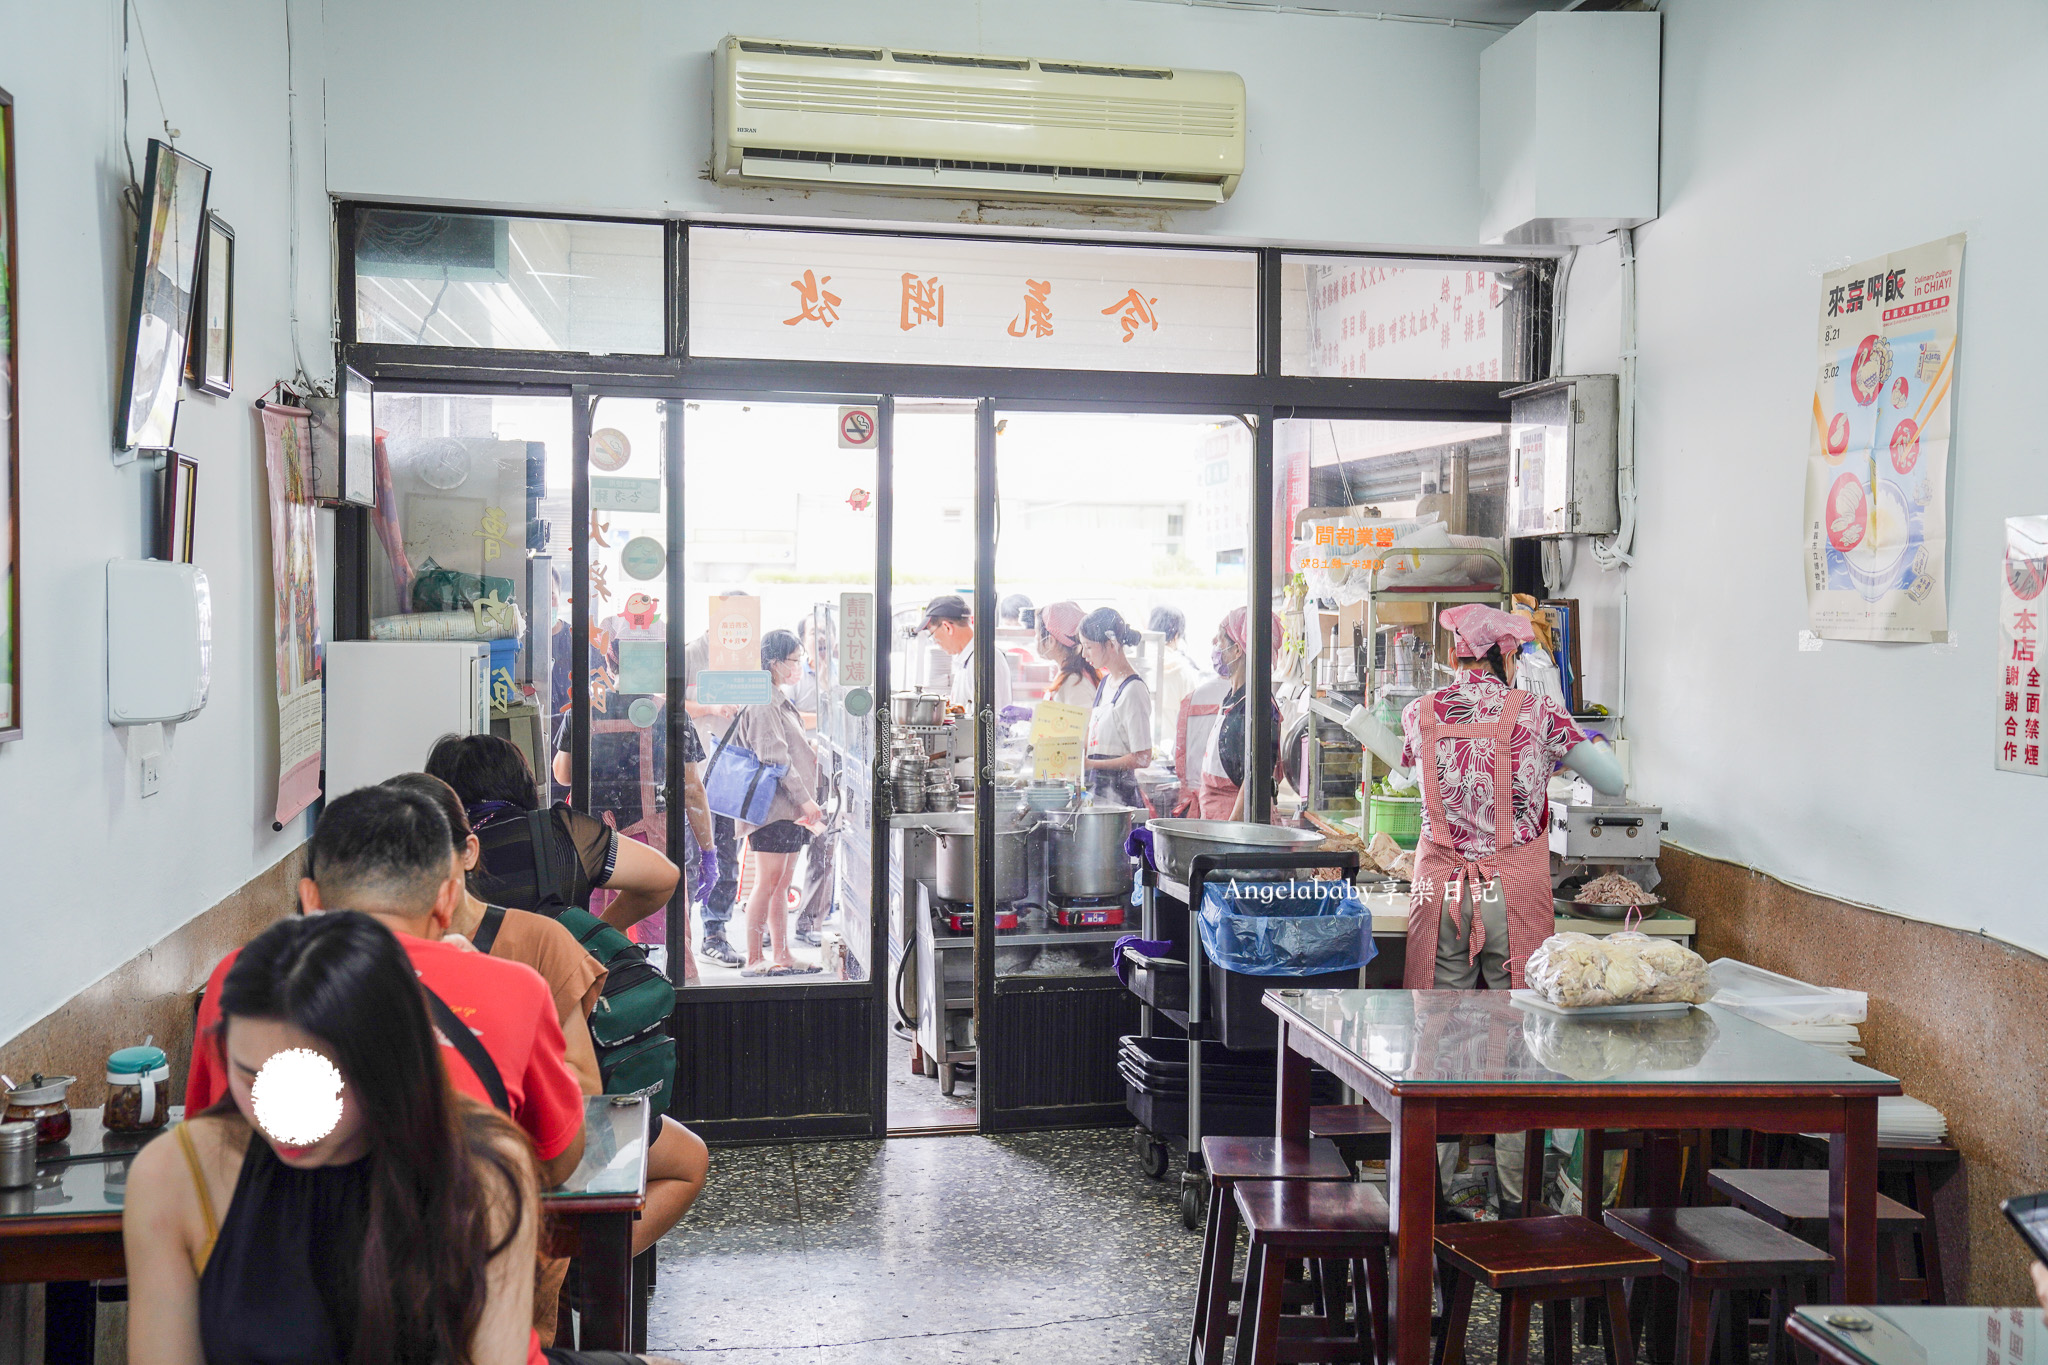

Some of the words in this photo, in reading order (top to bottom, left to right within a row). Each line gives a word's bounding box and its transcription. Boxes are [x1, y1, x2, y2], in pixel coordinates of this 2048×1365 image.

[1827, 268, 1907, 318] 來嘉呷飯
[1914, 274, 1934, 284] Culinary
[1935, 269, 1953, 279] Culture
[1914, 285, 1922, 296] in
[1924, 276, 1952, 294] CHIAYI
[1825, 328, 1840, 342] 8.21
[1824, 366, 1840, 379] 3.02
[2012, 608, 2037, 662] 本店
[2003, 665, 2019, 762] 謝謝合作
[2024, 667, 2041, 766] 全面禁煙
